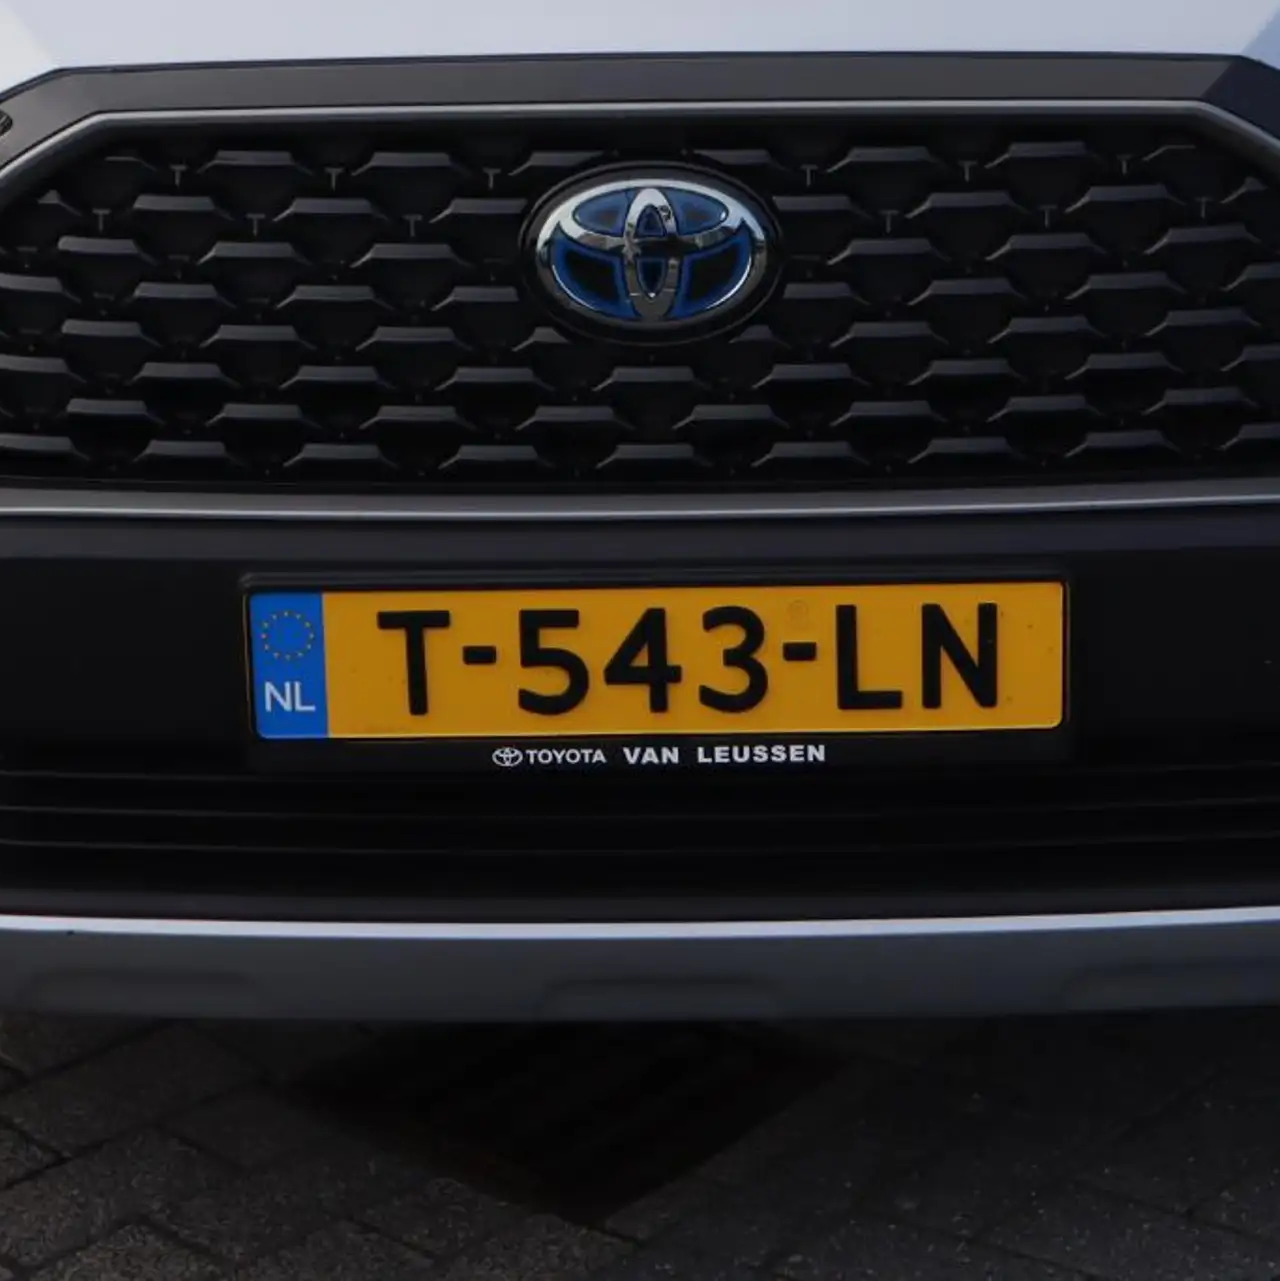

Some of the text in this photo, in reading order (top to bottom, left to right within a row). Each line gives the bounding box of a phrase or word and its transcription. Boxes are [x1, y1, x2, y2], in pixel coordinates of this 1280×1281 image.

[376, 602, 999, 717] T-543-LN
[264, 681, 316, 713] NL
[525, 744, 826, 765] TOYOTA VAN LEUSSEN
